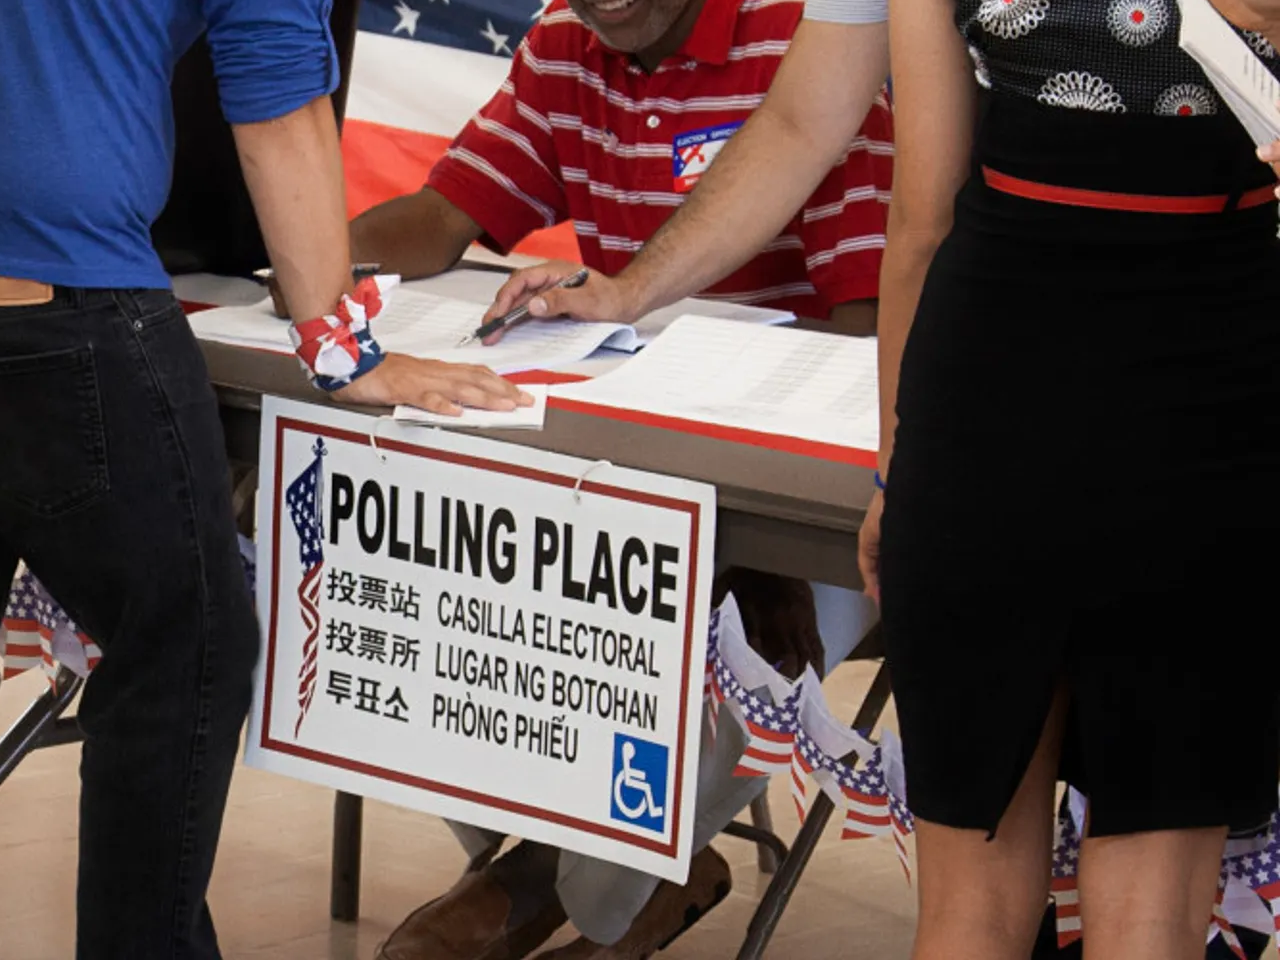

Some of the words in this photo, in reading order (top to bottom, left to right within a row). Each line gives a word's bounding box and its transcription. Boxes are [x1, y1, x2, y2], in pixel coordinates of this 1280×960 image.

[329, 472, 517, 585] POLLING
[532, 516, 680, 623] PLACE
[327, 567, 421, 621] 投票站
[326, 618, 421, 672] 投票所
[437, 591, 527, 646] CASILLA
[532, 612, 661, 679] ELECTORAL
[326, 670, 410, 724] 투표소
[435, 642, 508, 695] LUGAR
[514, 660, 546, 702] NG
[552, 670, 658, 732] BOTOHAN
[432, 691, 508, 746] PHÒNG
